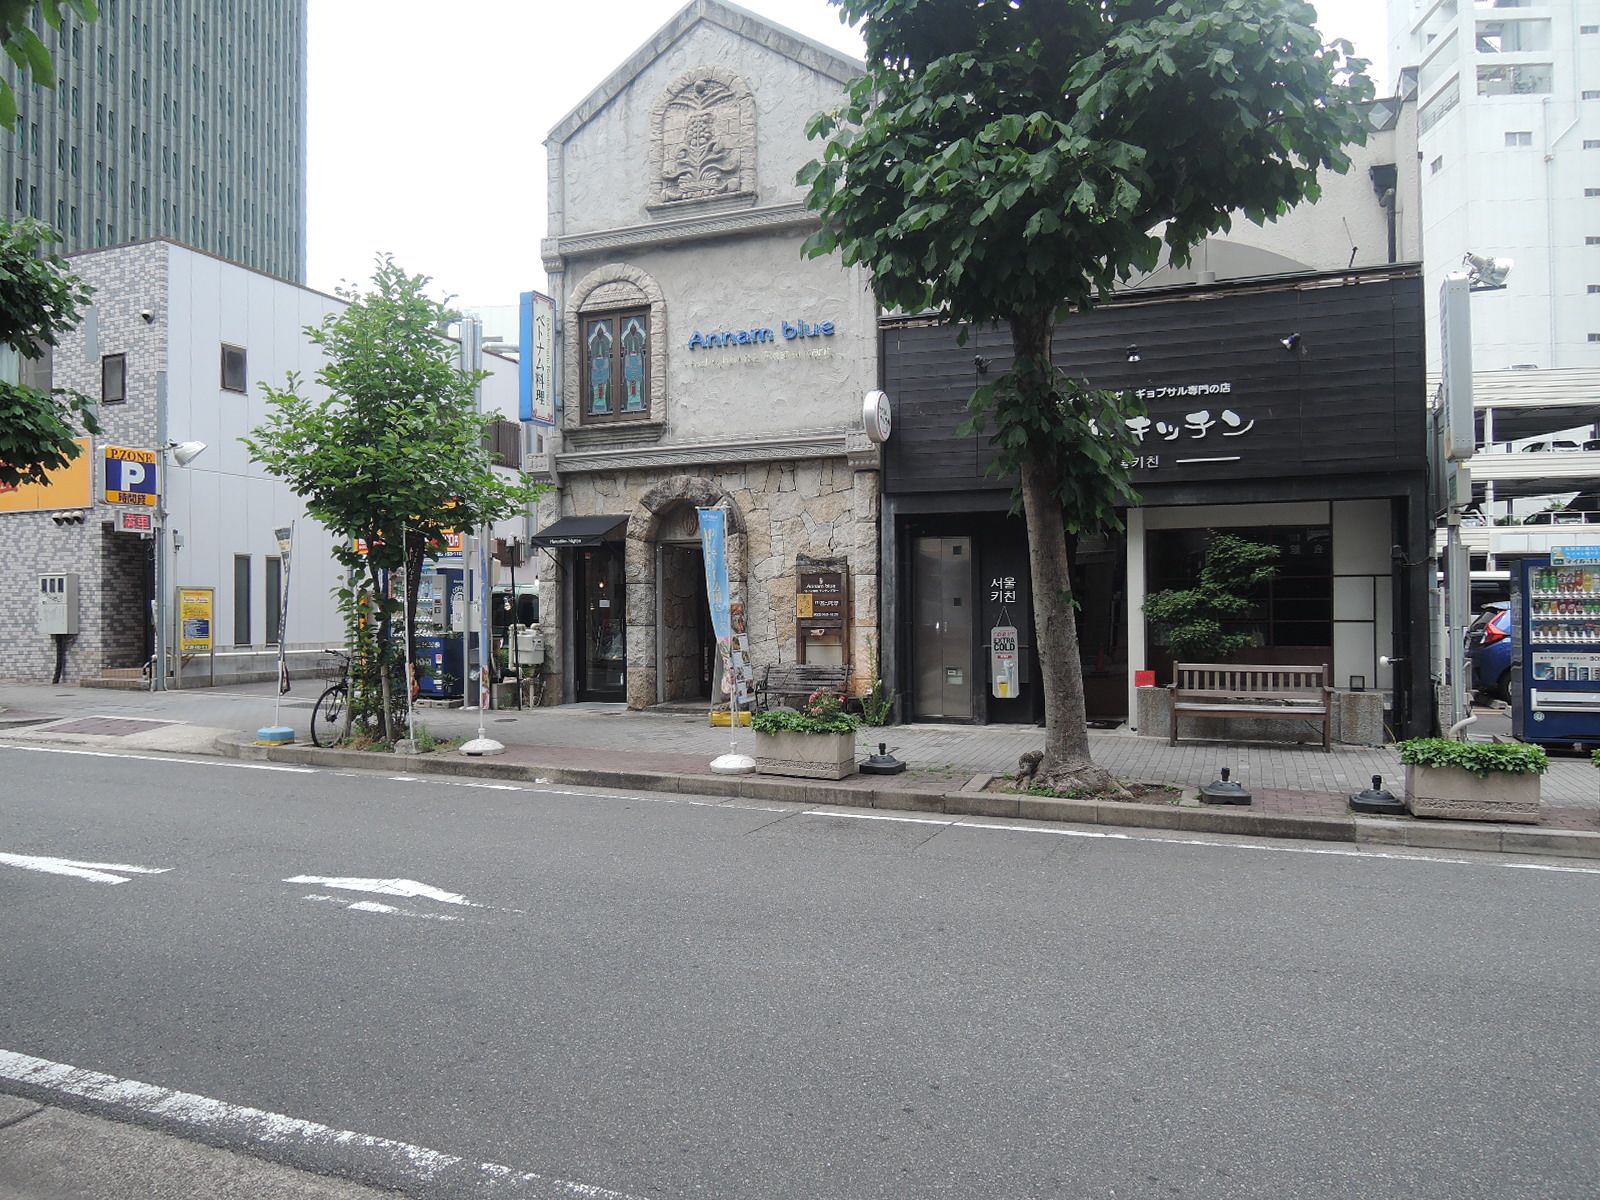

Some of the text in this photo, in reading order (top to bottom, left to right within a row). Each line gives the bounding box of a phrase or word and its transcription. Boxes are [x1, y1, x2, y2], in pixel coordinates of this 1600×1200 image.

[688, 319, 835, 350] Annam blue
[535, 314, 546, 406] ベトナム料理
[121, 460, 146, 492] P
[990, 576, 1017, 589] 서울
[990, 590, 1017, 603] 키친
[994, 636, 1015, 644] EXTRA
[994, 643, 1016, 651] COLD
